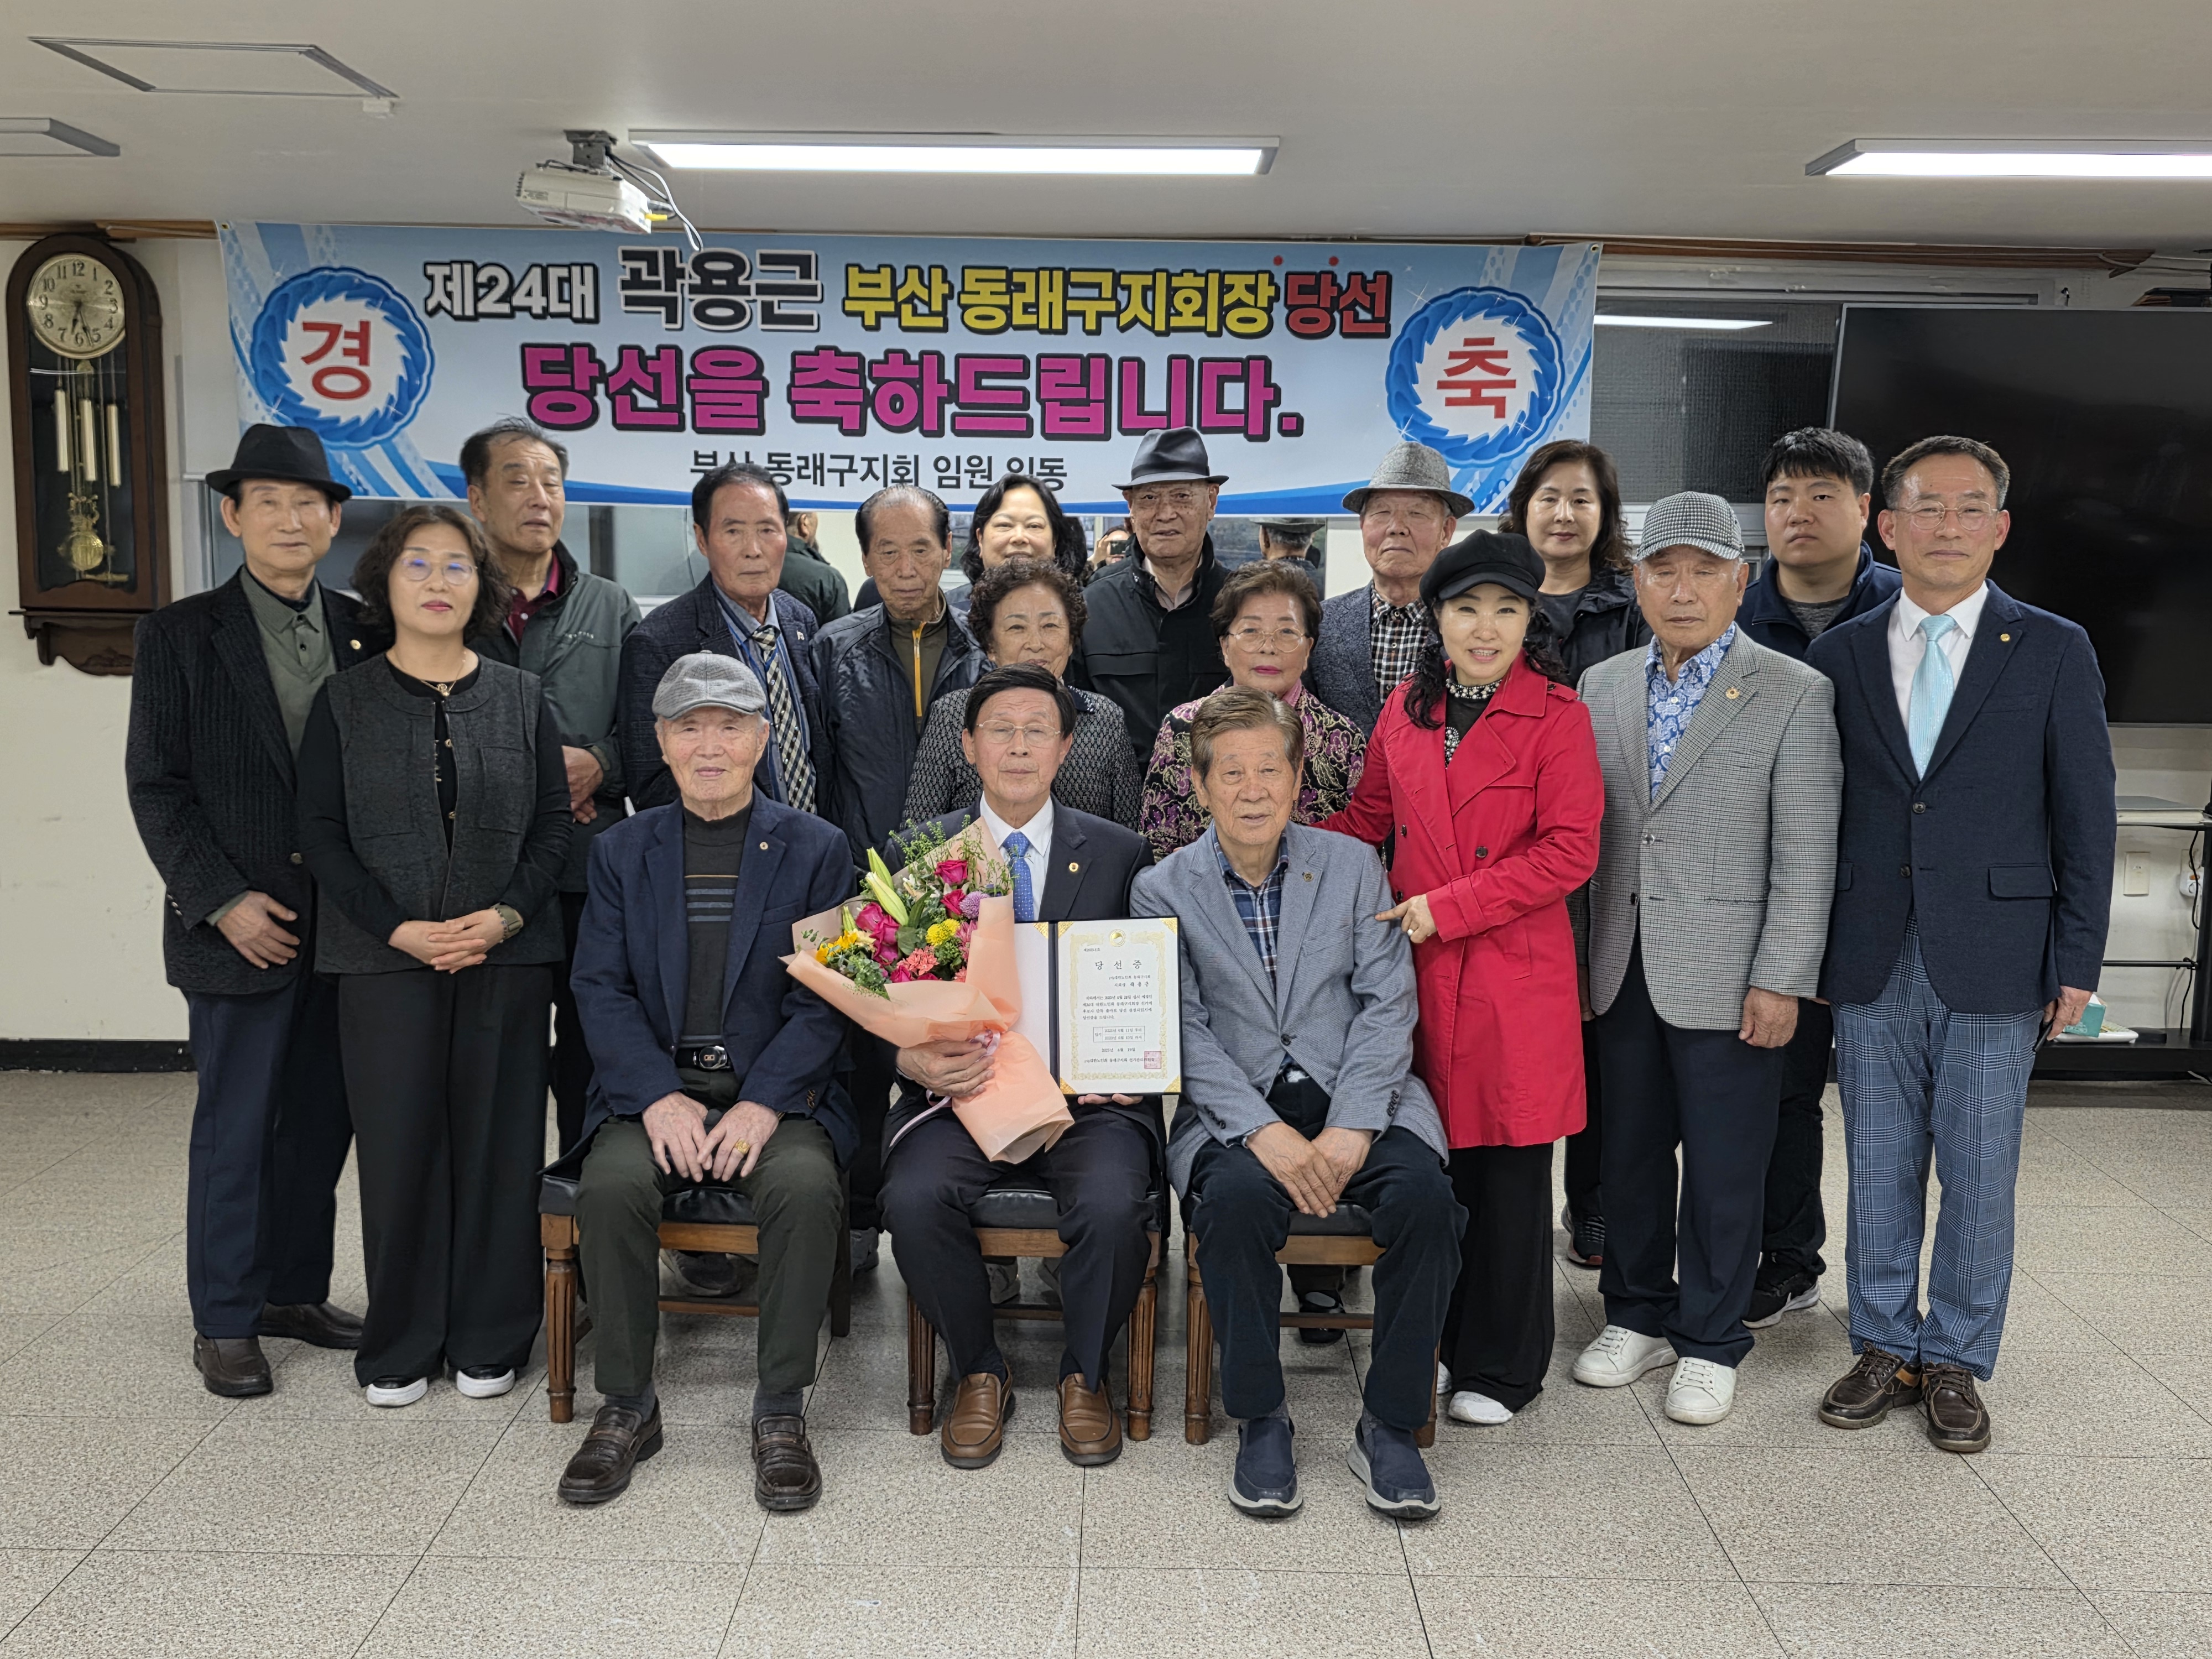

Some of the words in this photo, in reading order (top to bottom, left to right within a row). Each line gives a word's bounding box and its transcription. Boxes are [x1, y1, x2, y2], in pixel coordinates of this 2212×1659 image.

[58, 265, 66, 279] 11
[72, 260, 85, 276] 12
[44, 278, 55, 292] 10
[105, 279, 113, 295] 2
[424, 260, 600, 324] 제24대
[618, 246, 823, 332] 곽용근
[842, 264, 953, 333] 부산
[957, 266, 1276, 336] 동래구지회장
[1283, 270, 1392, 338] 당선
[39, 294, 48, 310] 9
[44, 314, 54, 328] 8
[103, 317, 113, 329] 4
[58, 327, 67, 342] 7
[75, 332, 84, 346] 6
[300, 321, 372, 401] 경
[1437, 336, 1517, 419] 축
[520, 343, 769, 436] 당선을
[787, 346, 1304, 442] 축하드립니다.
[765, 452, 919, 488] 동래구지회
[933, 455, 993, 489] 임원
[1095, 961, 1104, 970] 당
[1114, 960, 1122, 969] 선
[1133, 960, 1142, 969] 증
